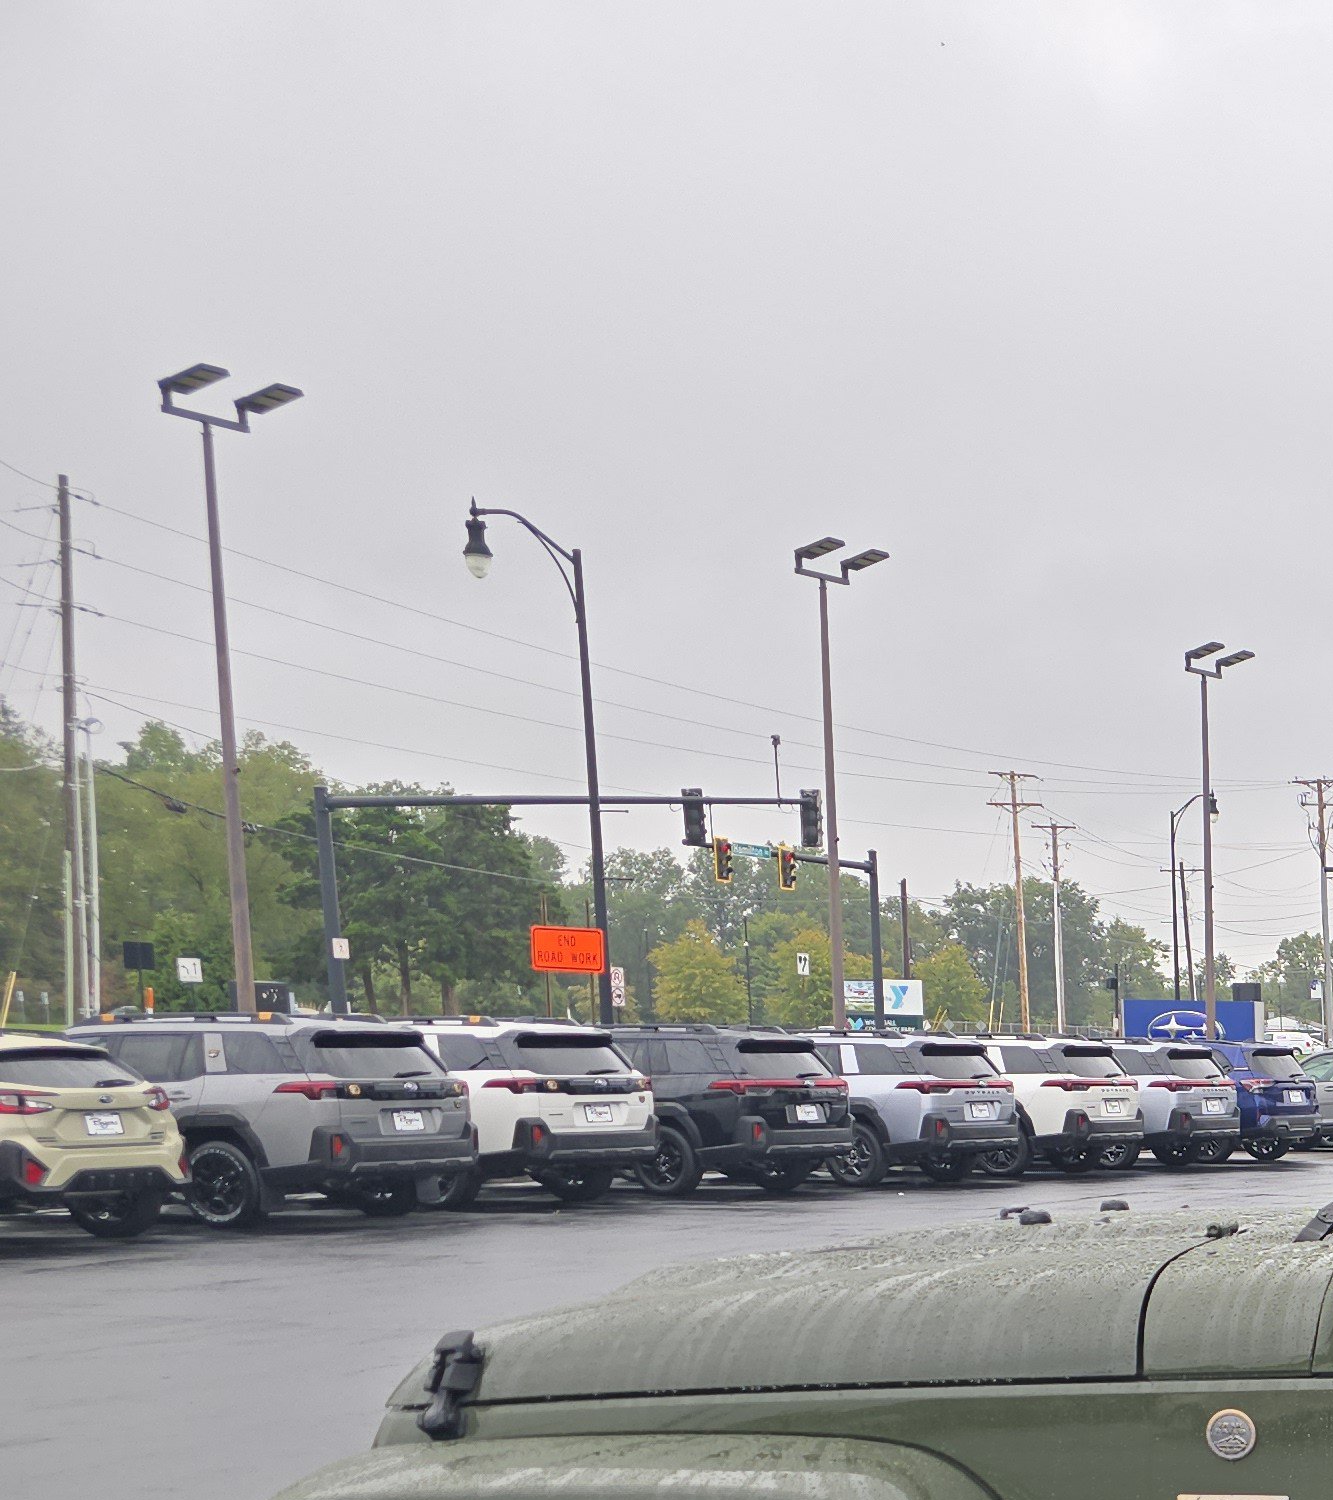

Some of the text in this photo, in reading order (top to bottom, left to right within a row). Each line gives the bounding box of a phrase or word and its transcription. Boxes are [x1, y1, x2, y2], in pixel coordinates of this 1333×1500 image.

[557, 934, 576, 947] END
[537, 950, 599, 965] ROAD WORK
